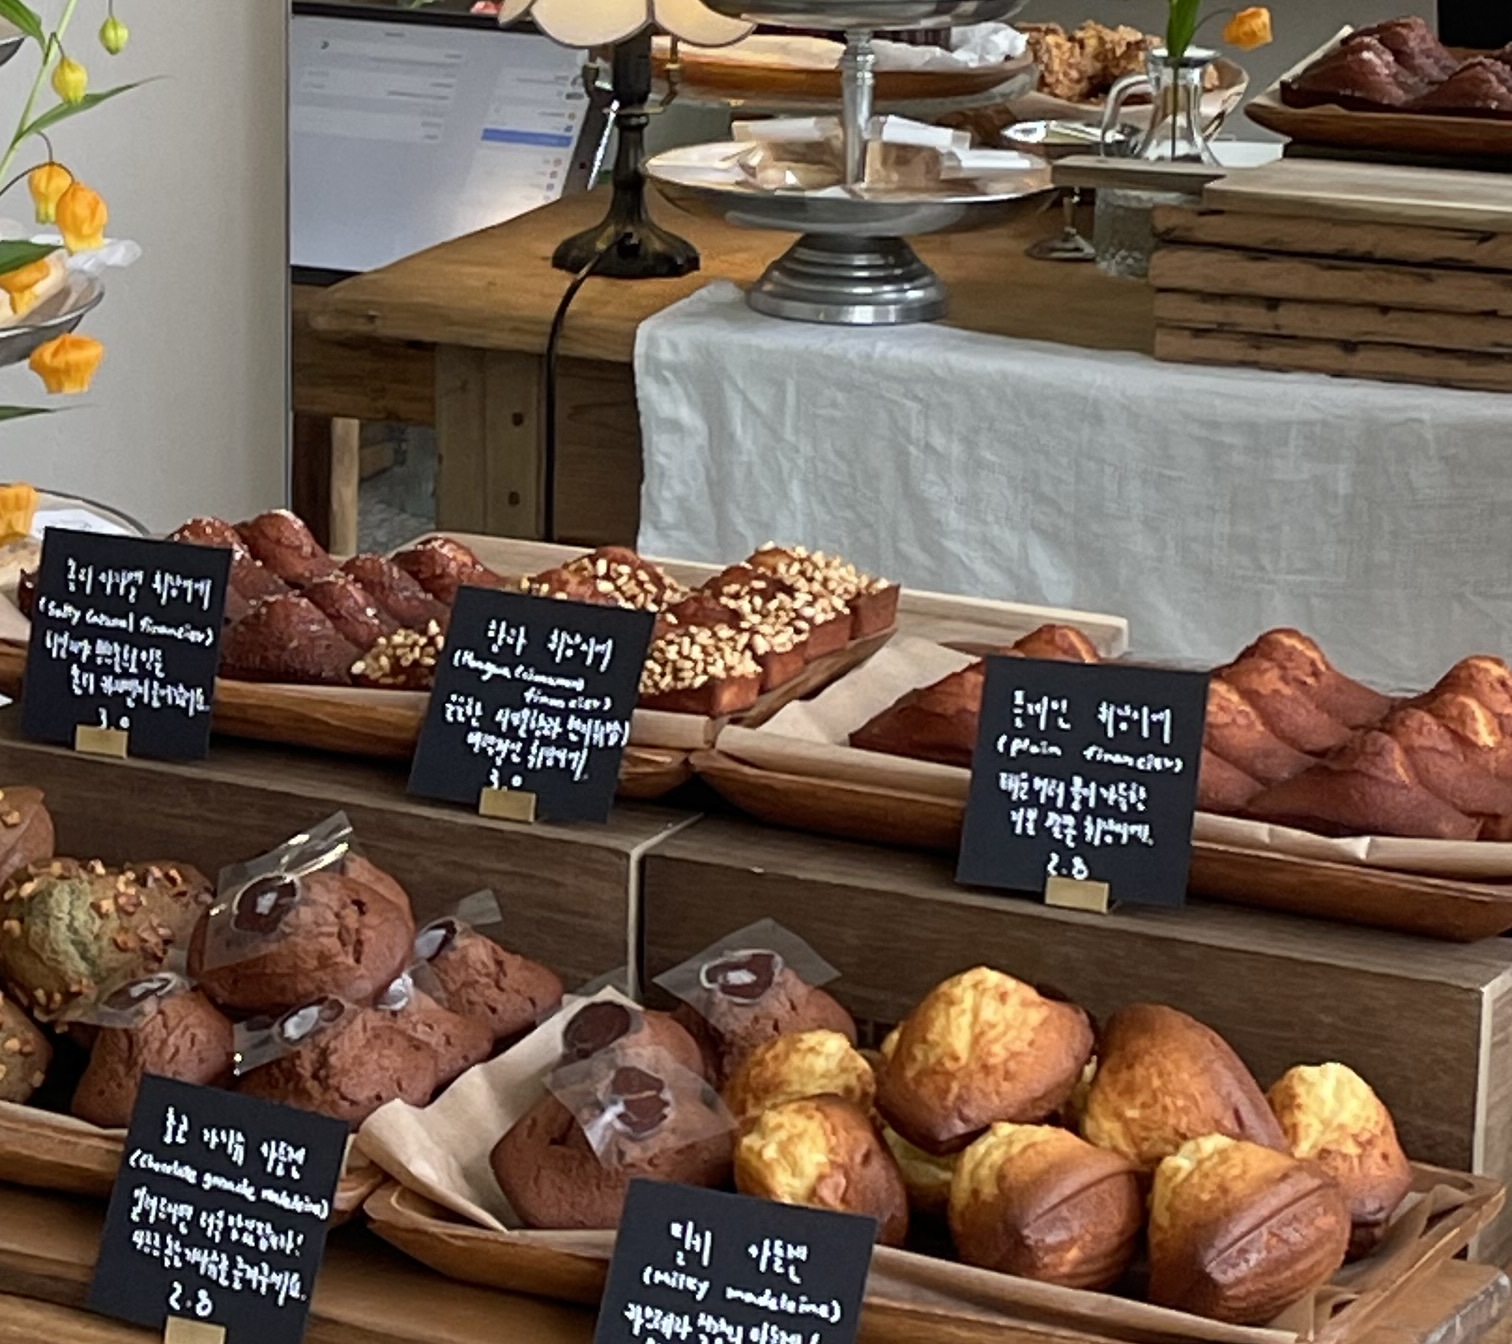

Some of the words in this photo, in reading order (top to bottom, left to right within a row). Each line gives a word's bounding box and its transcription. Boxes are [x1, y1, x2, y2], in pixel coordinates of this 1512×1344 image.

[152, 569, 212, 611] 휘낭시에
[547, 628, 614, 673] 휘낭시에
[1013, 689, 1071, 731] 플레인
[1098, 701, 1172, 745] 휘낭시에
[1033, 776, 1066, 809] 버터
[1100, 782, 1147, 812] 가득한
[1047, 852, 1089, 881] 2.8
[260, 1140, 306, 1179] 마들렌
[670, 1221, 712, 1267] 밀키
[748, 1238, 808, 1284] 마들렌
[169, 1281, 213, 1317] 2.8
